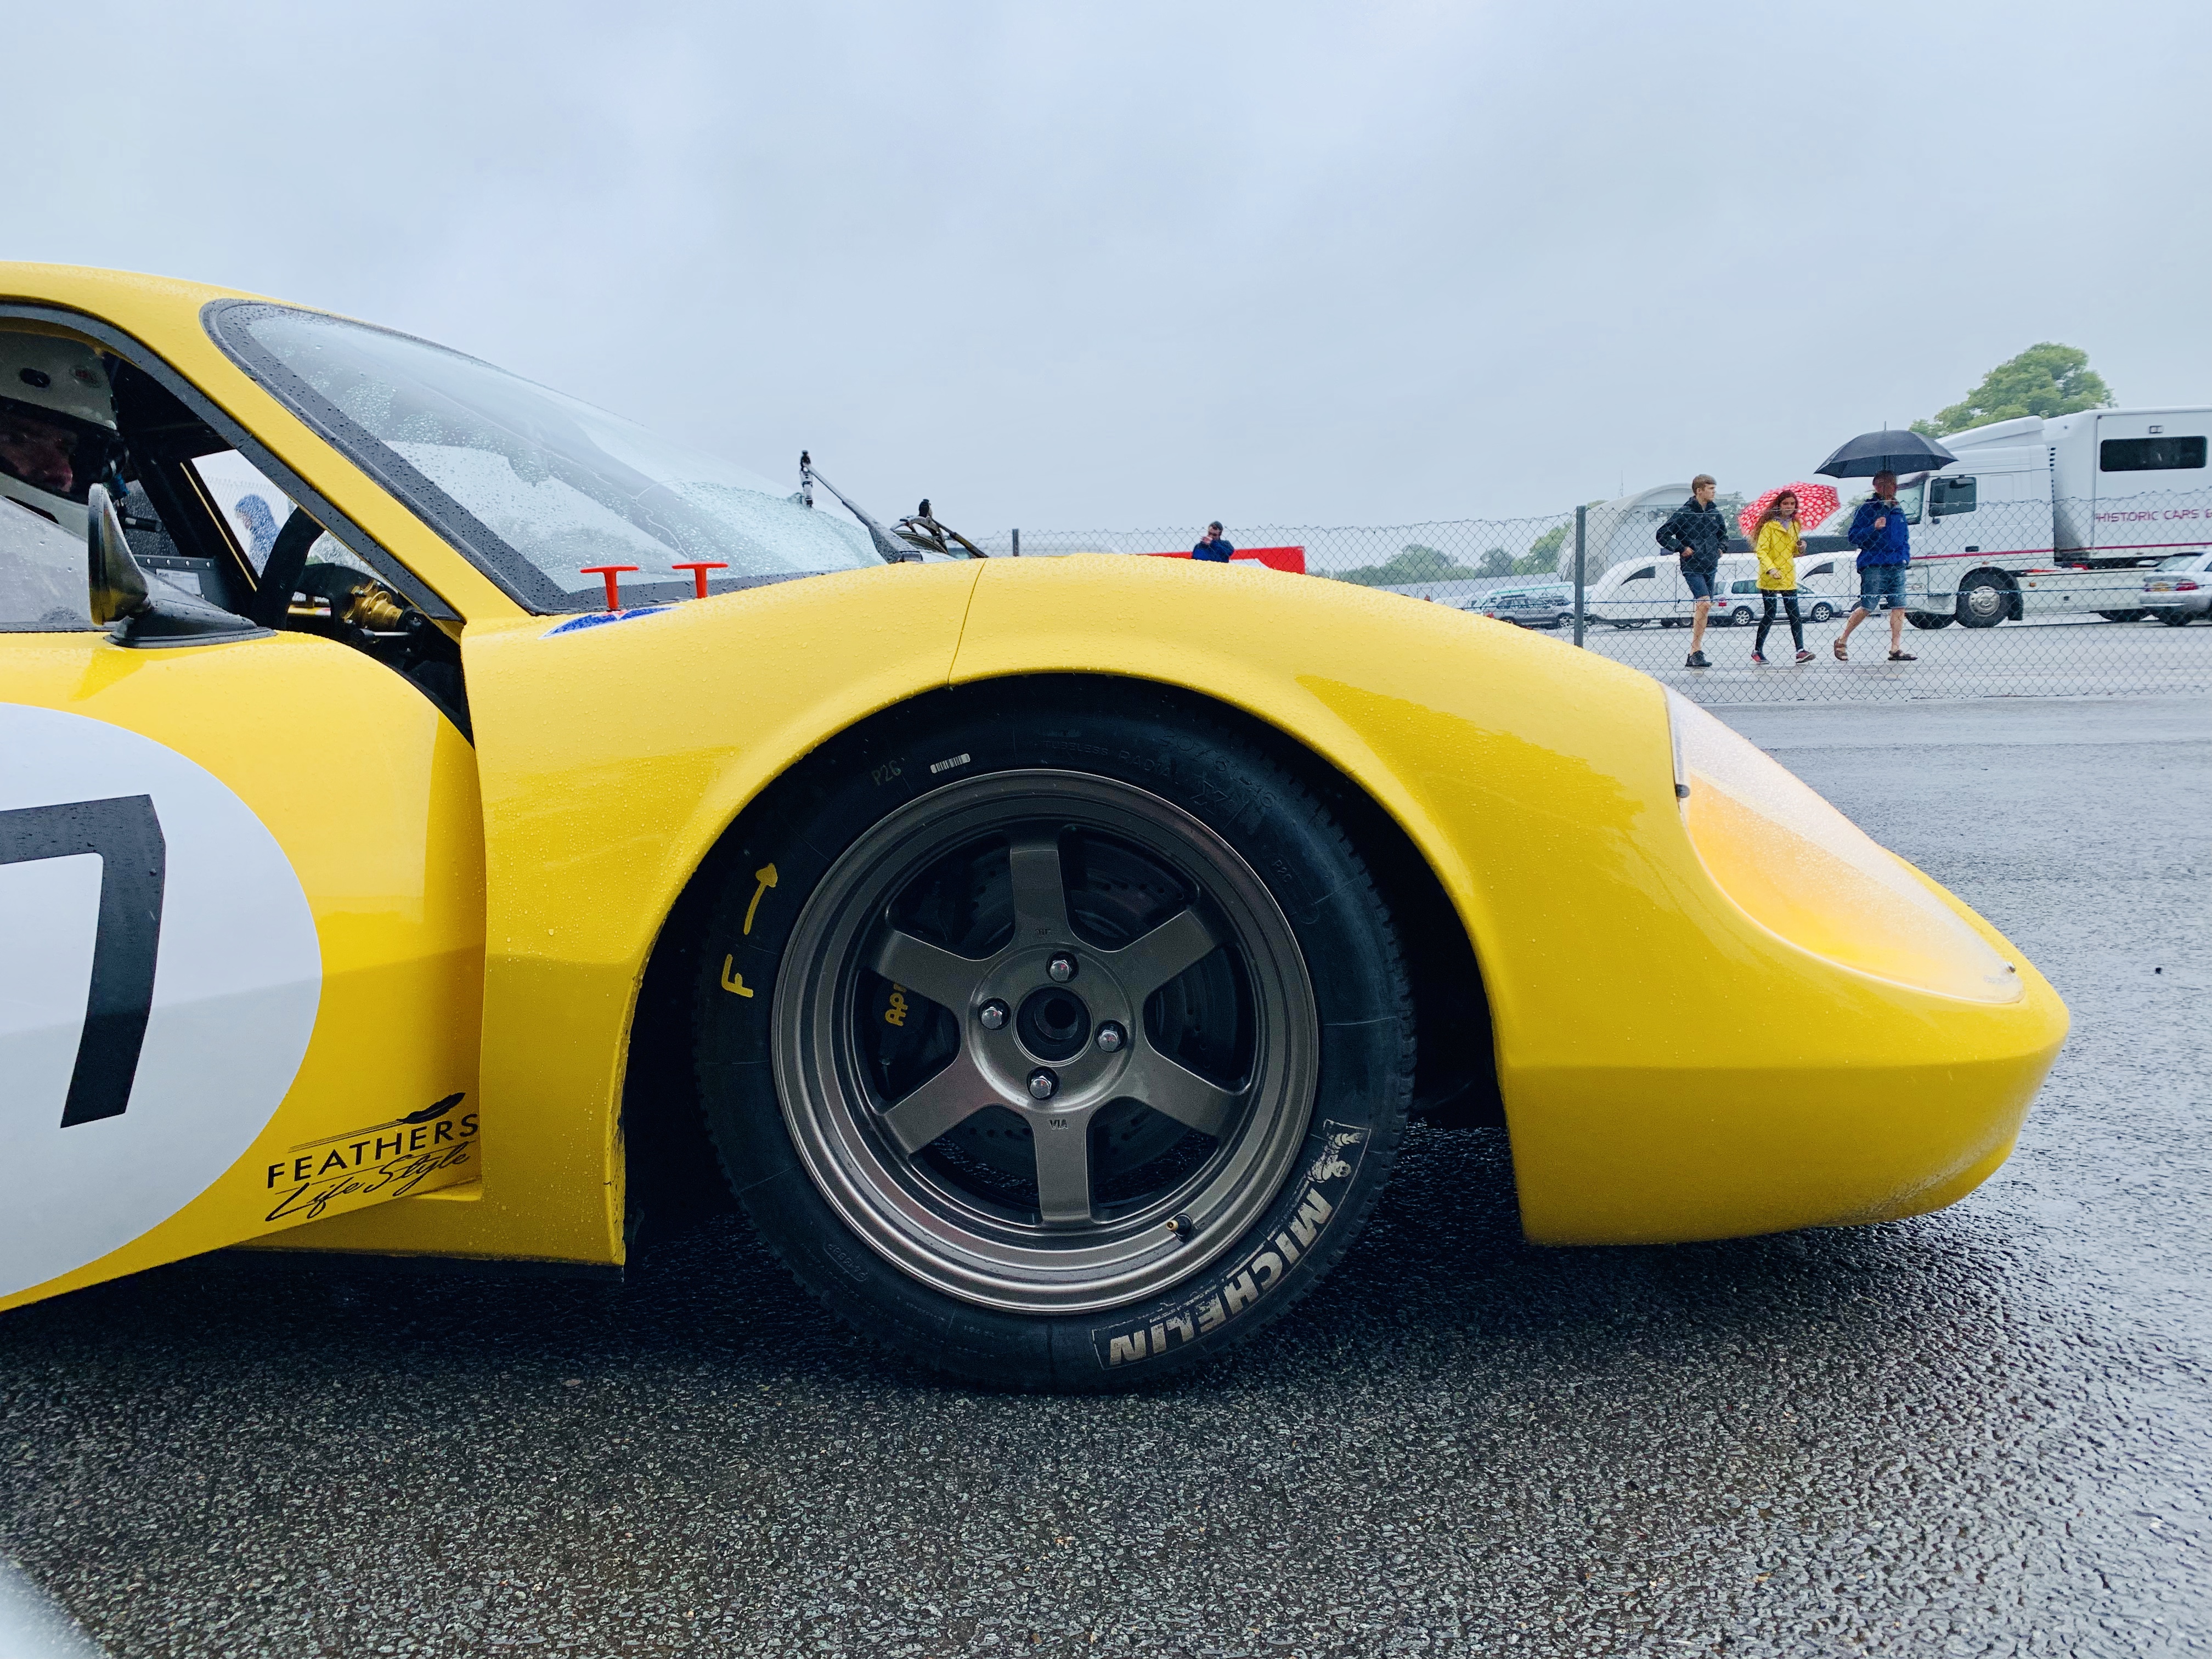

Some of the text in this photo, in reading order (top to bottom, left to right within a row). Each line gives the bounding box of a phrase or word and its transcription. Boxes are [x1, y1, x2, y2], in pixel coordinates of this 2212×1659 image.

[2096, 511, 2160, 522] HISTORIC
[2164, 509, 2199, 520] CARS
[721, 954, 754, 998] F
[267, 1113, 478, 1189] FEATHERS
[1109, 1188, 1333, 1366] MICHELIN
